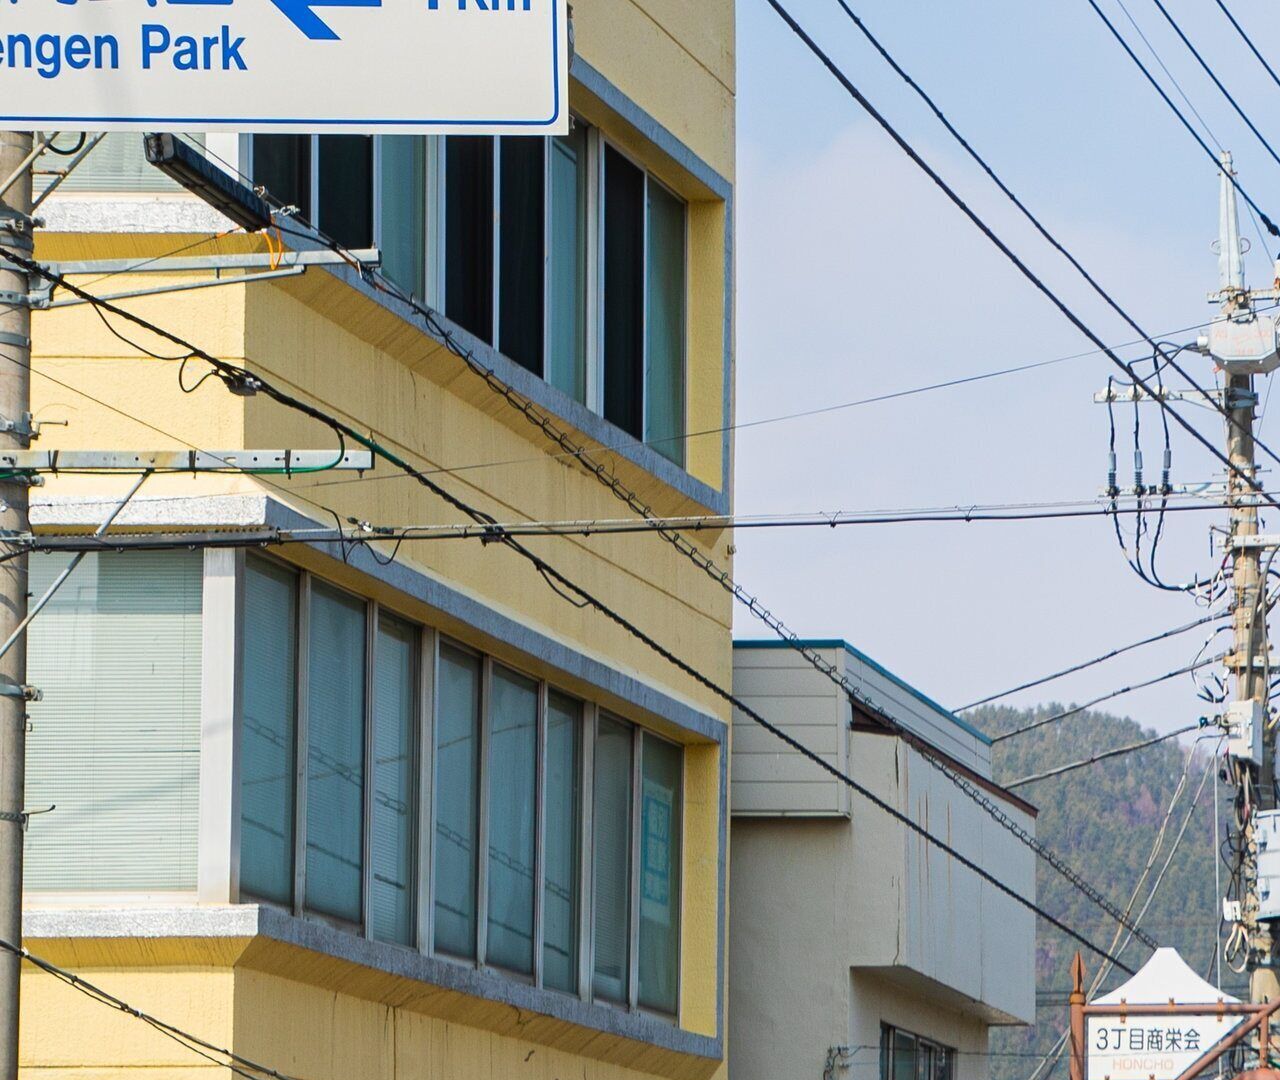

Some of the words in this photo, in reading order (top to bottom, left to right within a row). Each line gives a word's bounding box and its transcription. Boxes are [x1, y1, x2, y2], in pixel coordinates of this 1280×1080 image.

[0, 34, 118, 79] ngen
[141, 24, 248, 71] Park
[1096, 1028, 1201, 1051] 3丁目商栄会
